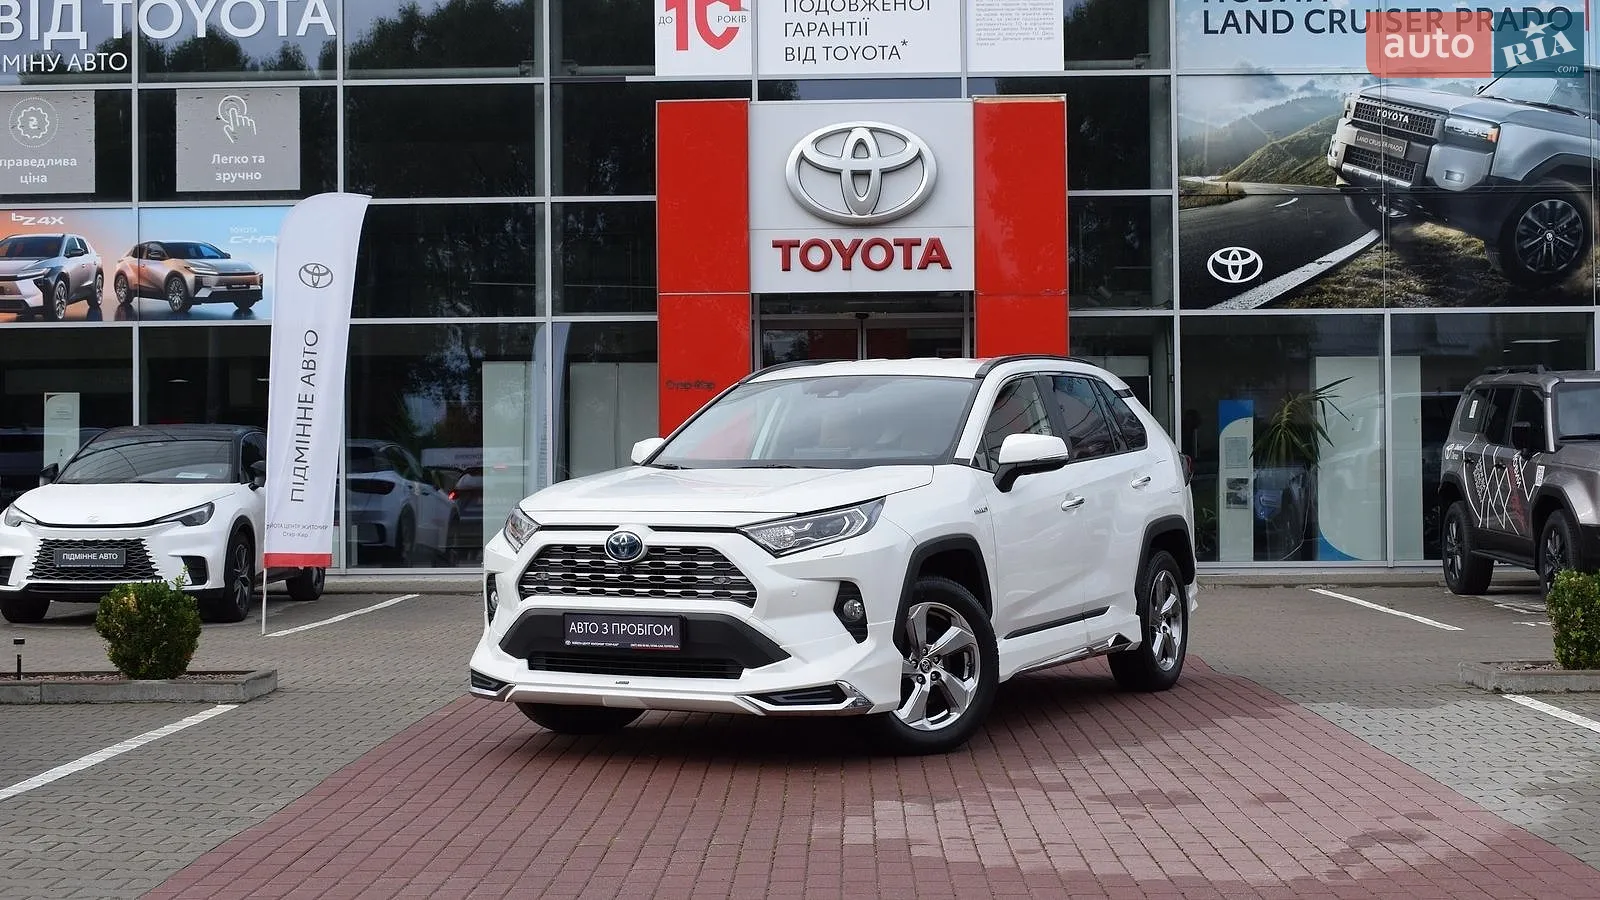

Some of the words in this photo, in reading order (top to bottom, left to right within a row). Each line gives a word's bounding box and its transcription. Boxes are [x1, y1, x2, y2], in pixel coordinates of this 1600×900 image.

[0, 0, 88, 50] ВІД
[659, 16, 673, 25] ДО
[717, 15, 747, 23] РОКІВ
[784, 17, 870, 37] ГАРАНТІЇ
[1203, 9, 1294, 35] LAND
[1304, 7, 1445, 34] CRUISER
[1455, 6, 1573, 32] PRADO
[3, 53, 61, 72] МІНУ
[67, 52, 128, 71] АВТО
[784, 46, 817, 64] ВІД
[1377, 109, 1409, 123] TOYOTA
[1357, 135, 1369, 143] LAND
[211, 153, 249, 164] Легко
[251, 155, 265, 164] та
[20, 172, 48, 185] ціна
[215, 171, 262, 183] зручно
[771, 237, 953, 273] TOYOTA
[300, 329, 319, 387] АВТО
[290, 393, 315, 503] ПІДМІННЕ
[62, 553, 98, 561] ПІДМІННЕ
[569, 621, 599, 634] АВТО
[611, 622, 674, 636] ПРОБІГОМ
